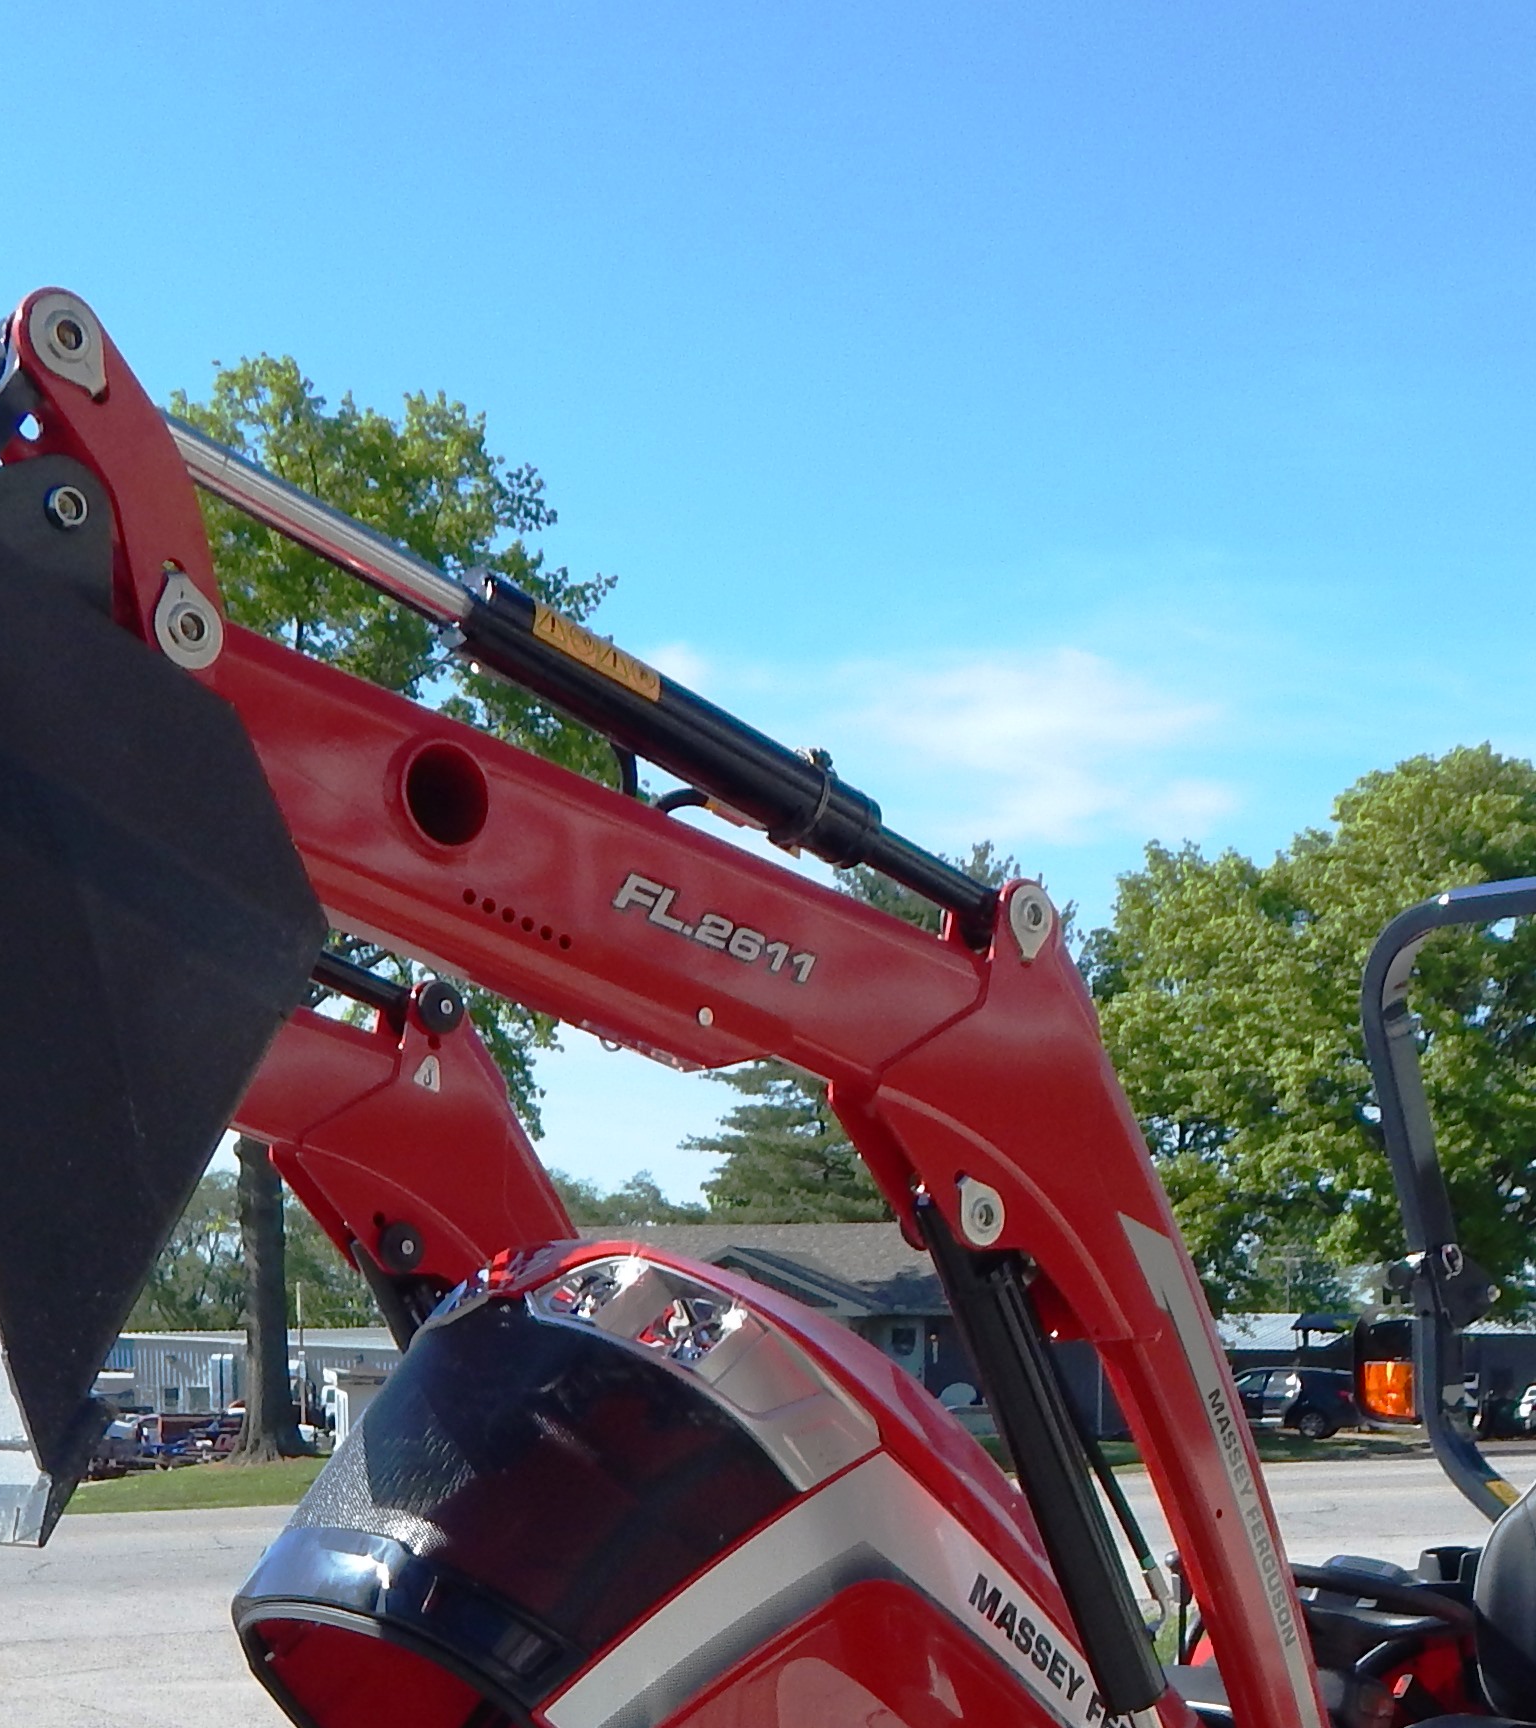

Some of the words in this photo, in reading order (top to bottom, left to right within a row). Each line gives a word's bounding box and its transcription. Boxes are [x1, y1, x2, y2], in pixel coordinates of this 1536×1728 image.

[612, 872, 817, 985] FL.2611
[1207, 1387, 1255, 1499] MASSEY
[1245, 1502, 1298, 1649] FERGUSON
[968, 1572, 1086, 1703] MASSEY
